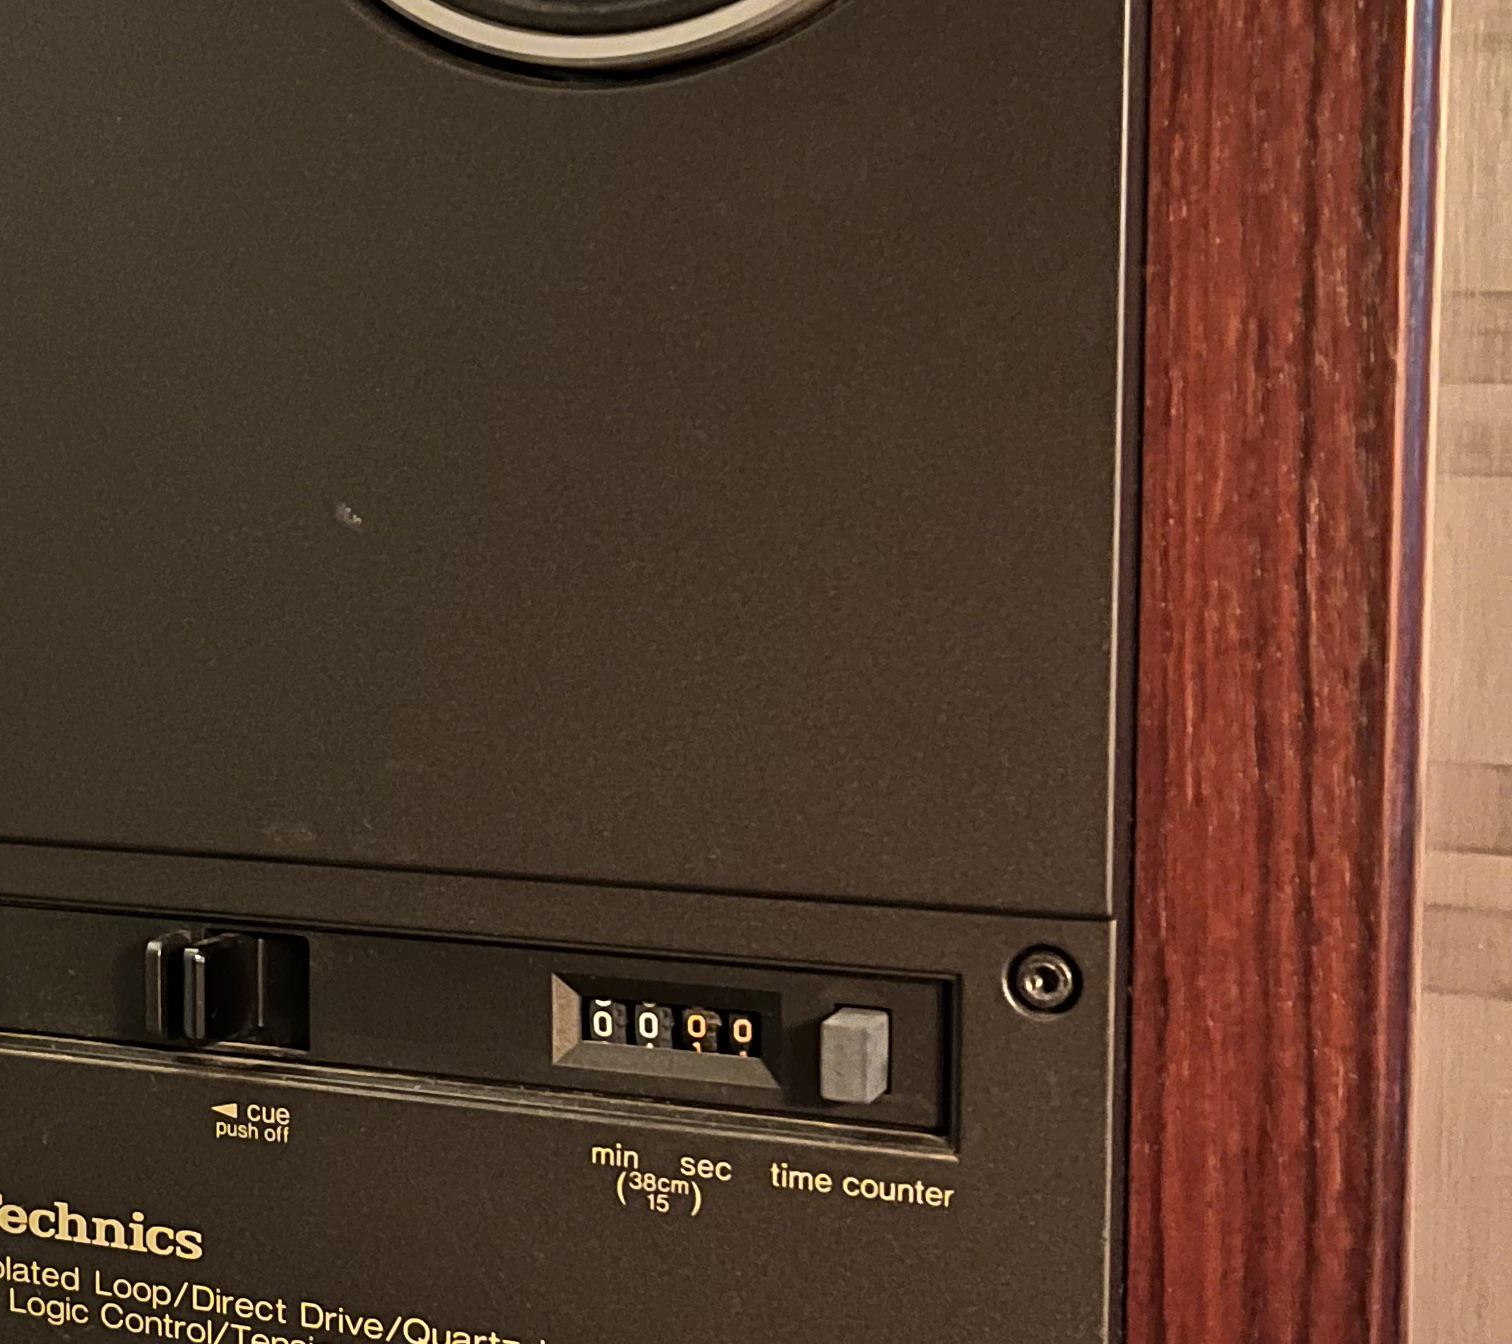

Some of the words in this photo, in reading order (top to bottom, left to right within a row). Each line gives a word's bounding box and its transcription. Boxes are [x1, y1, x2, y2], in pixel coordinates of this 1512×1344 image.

[215, 1119, 260, 1141] push
[263, 1122, 292, 1145] off
[245, 1102, 291, 1126] cue
[591, 1142, 639, 1169] min
[680, 1156, 733, 1184] sec
[770, 1163, 833, 1194] time
[842, 1174, 956, 1208] counter
[8, 1286, 90, 1328] Logic
[94, 1269, 288, 1326] Loop/Direct
